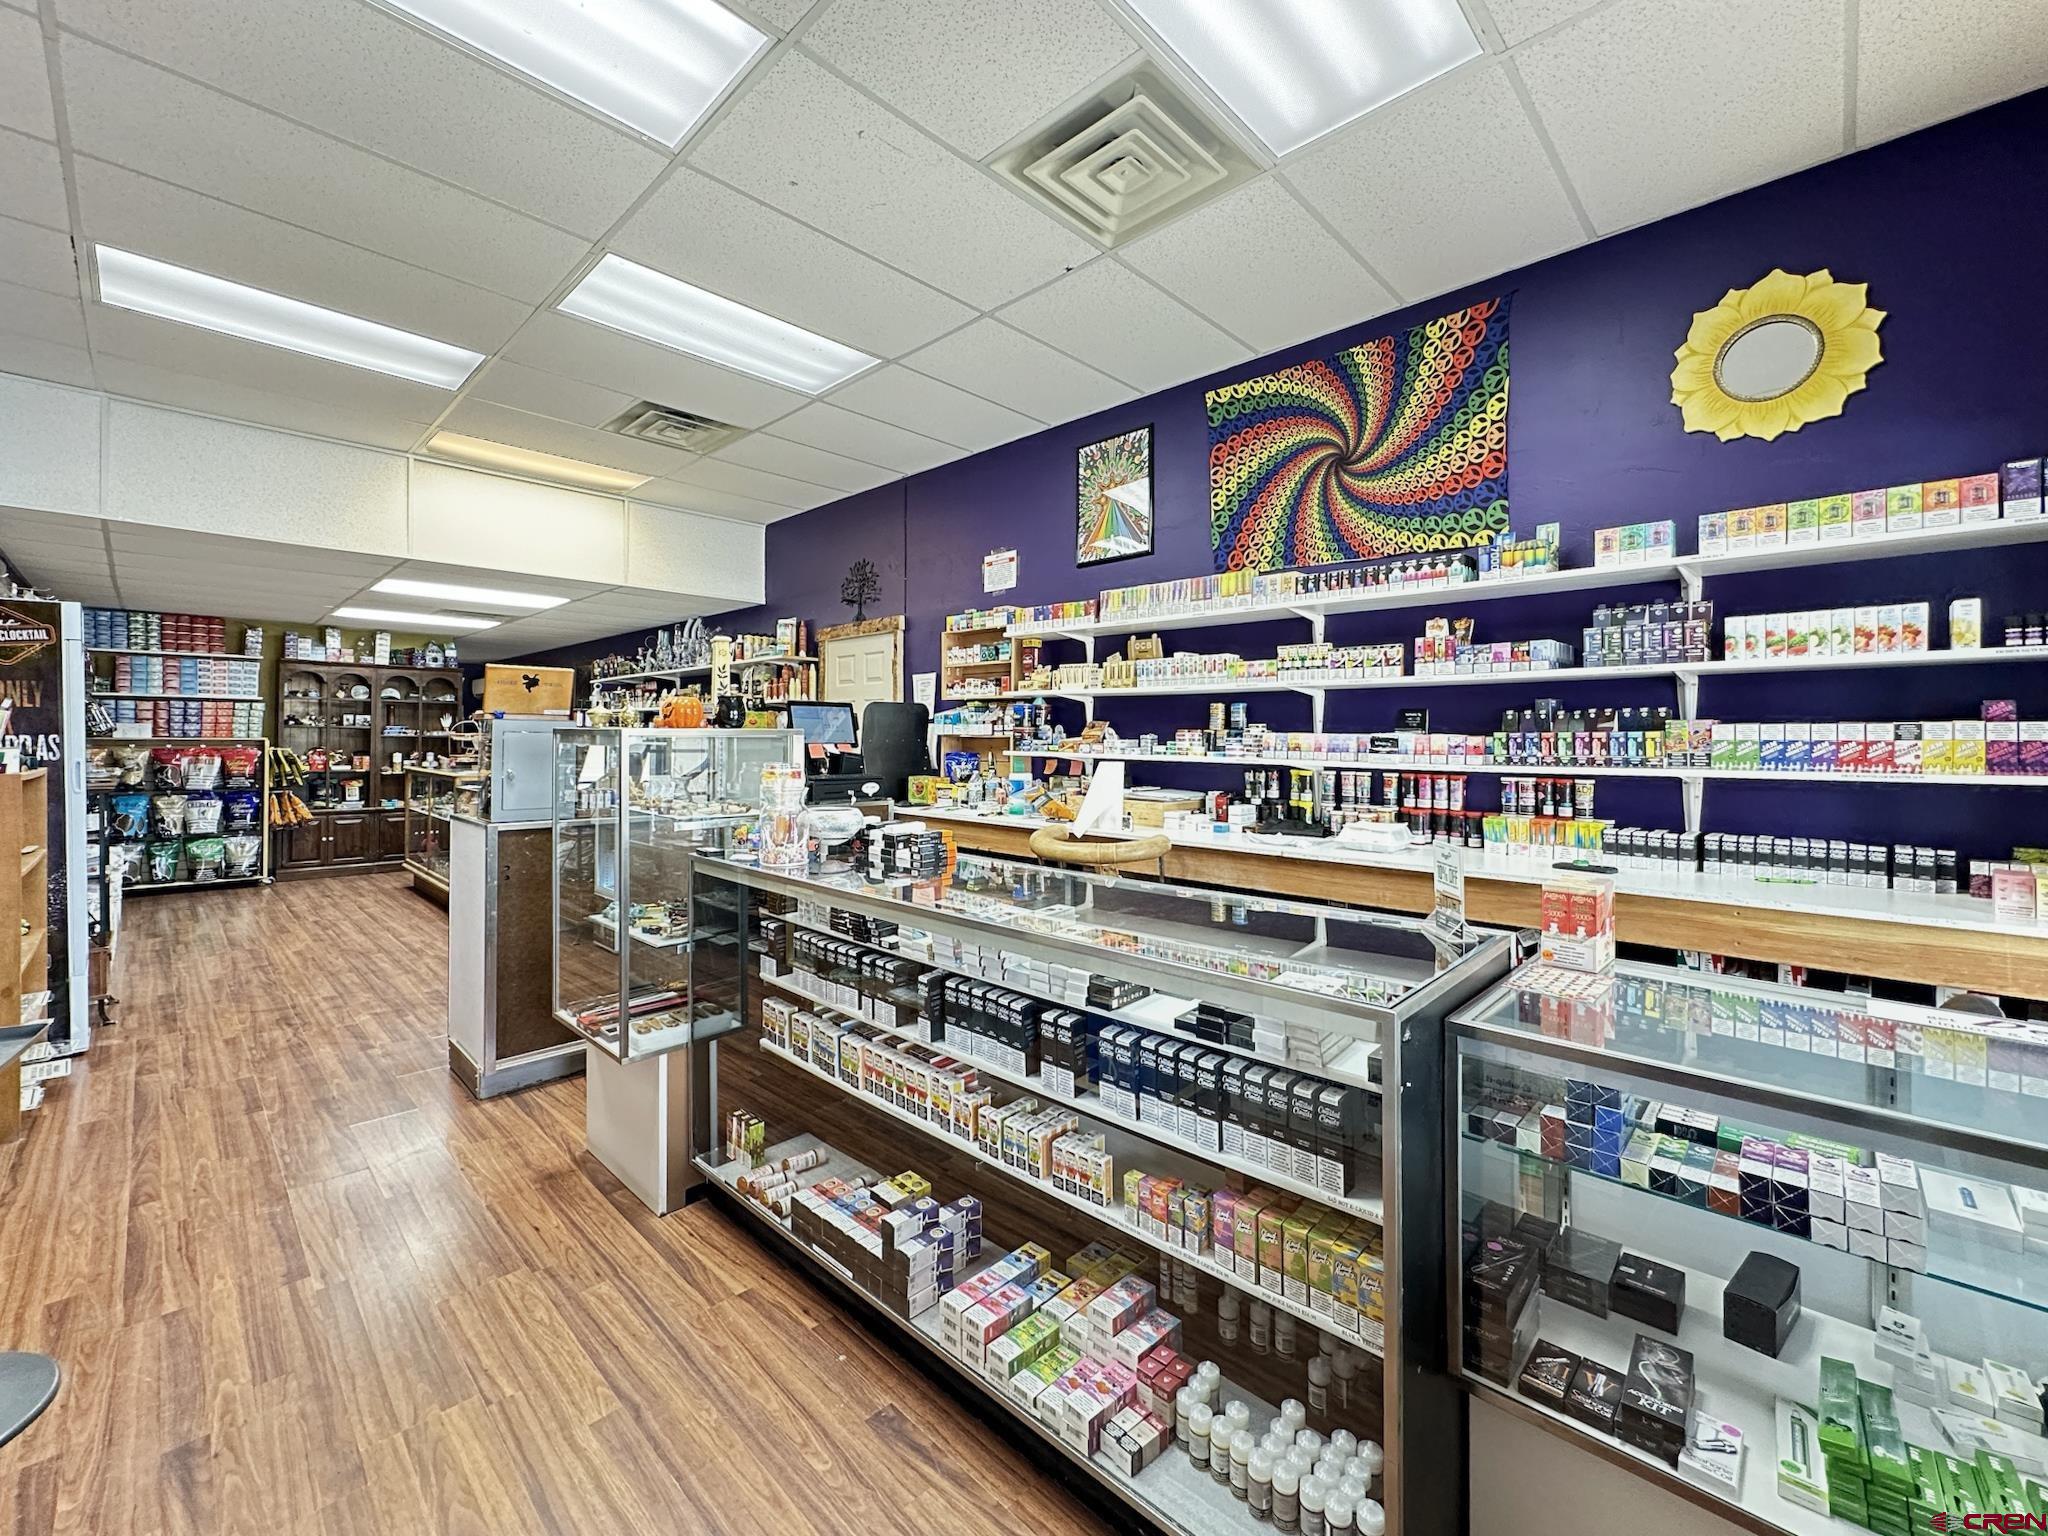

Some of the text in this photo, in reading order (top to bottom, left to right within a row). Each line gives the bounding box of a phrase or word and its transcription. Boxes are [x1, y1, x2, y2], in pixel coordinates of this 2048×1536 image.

[1134, 641, 1153, 650] OCB
[37, 734, 60, 761] AS
[1638, 1397, 1672, 1415] KIT
